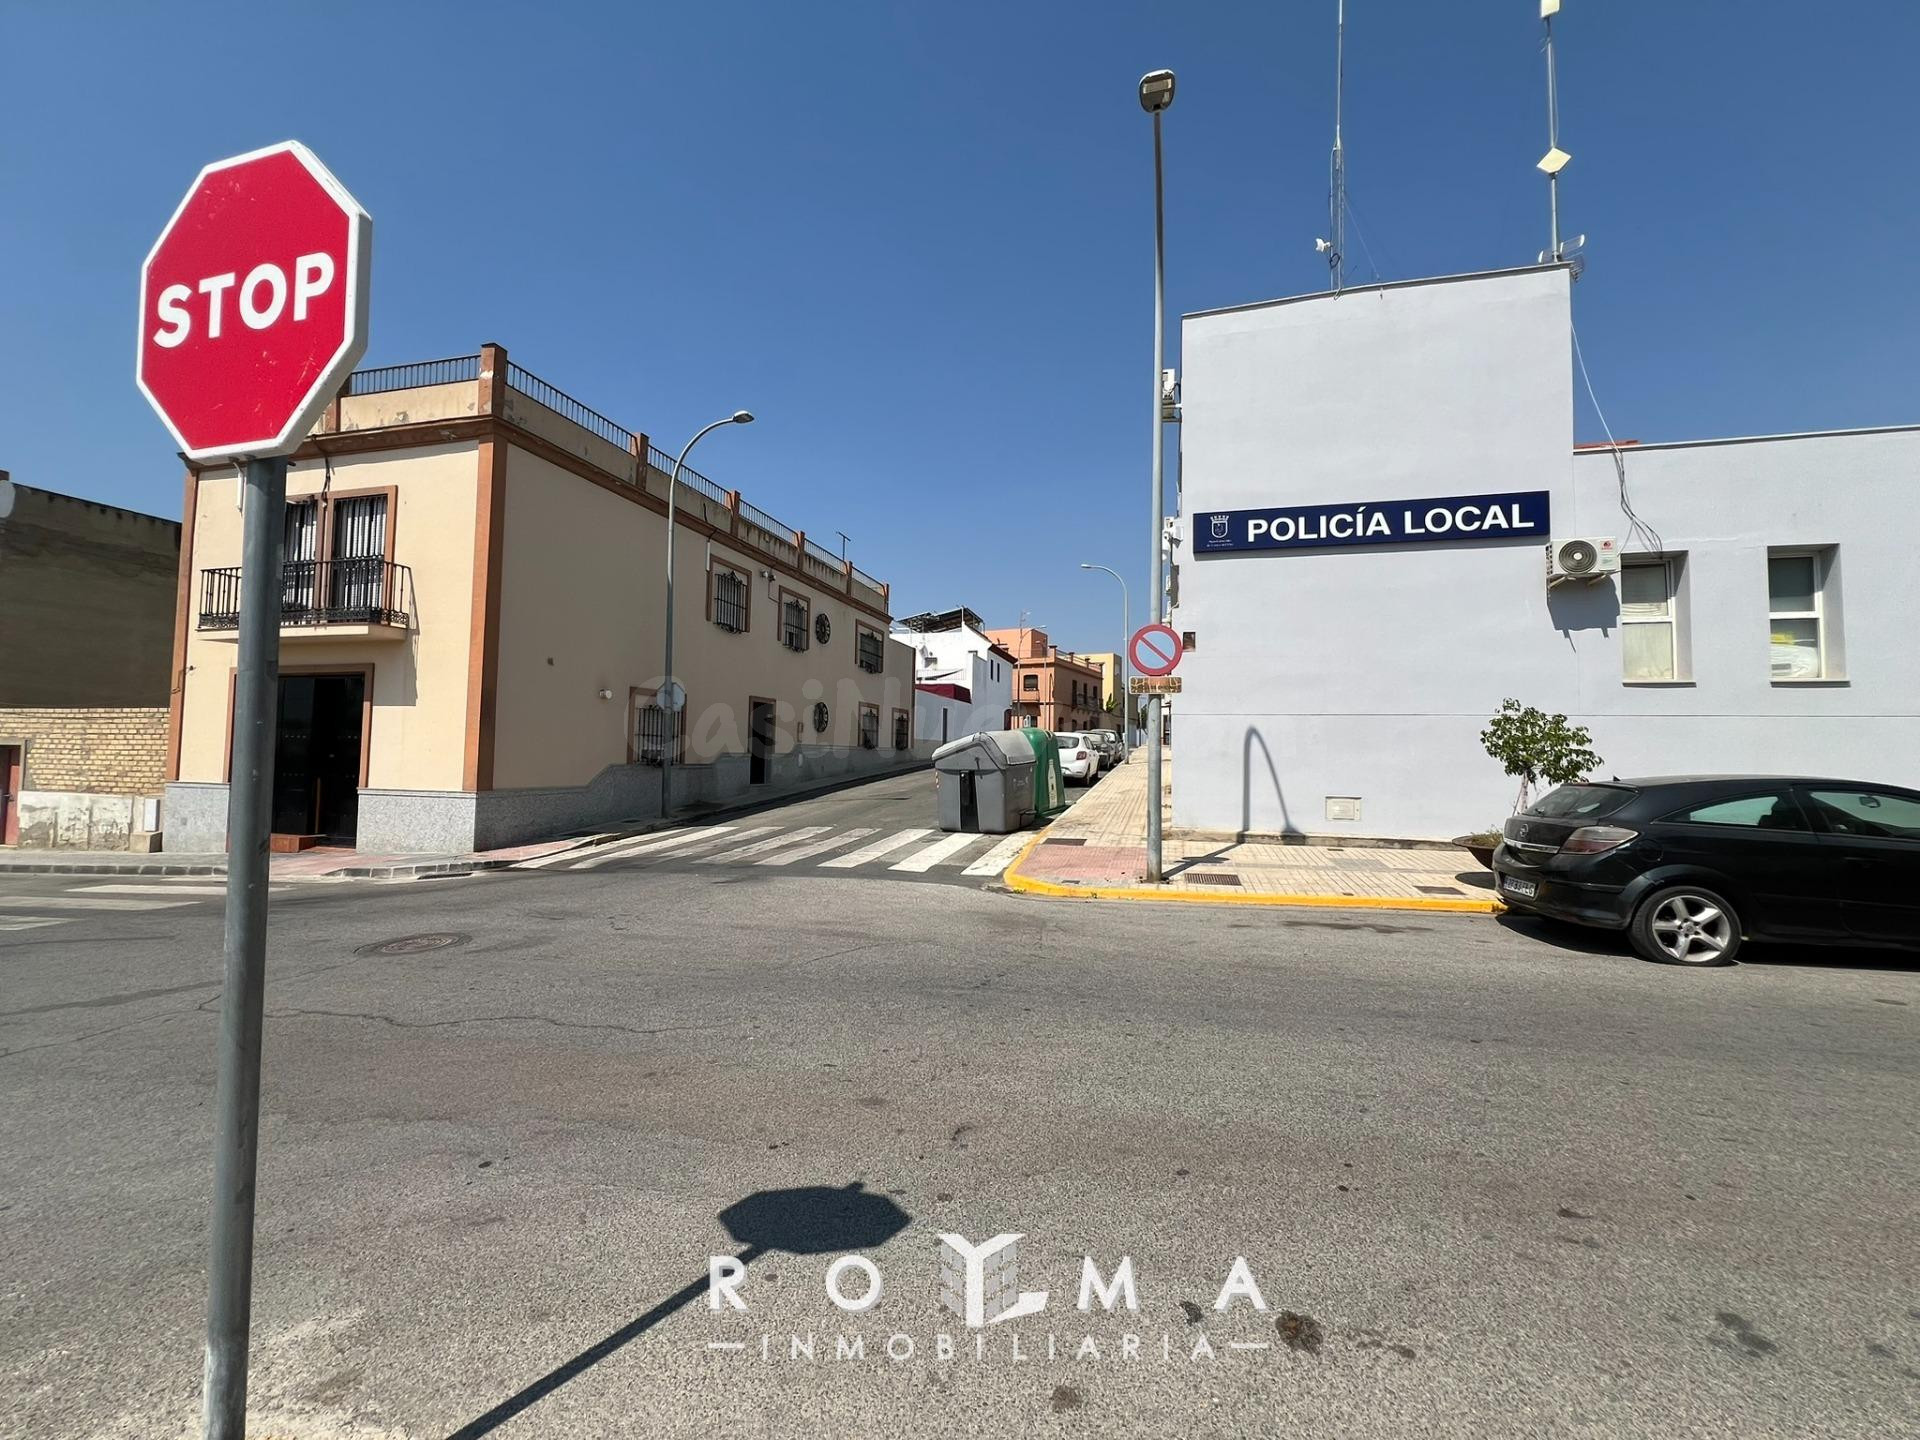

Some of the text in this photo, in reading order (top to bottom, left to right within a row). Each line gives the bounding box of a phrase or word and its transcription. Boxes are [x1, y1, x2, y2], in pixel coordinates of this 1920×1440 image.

[153, 252, 335, 348] STOP
[1247, 504, 1535, 543] POLICÍA LOCAL
